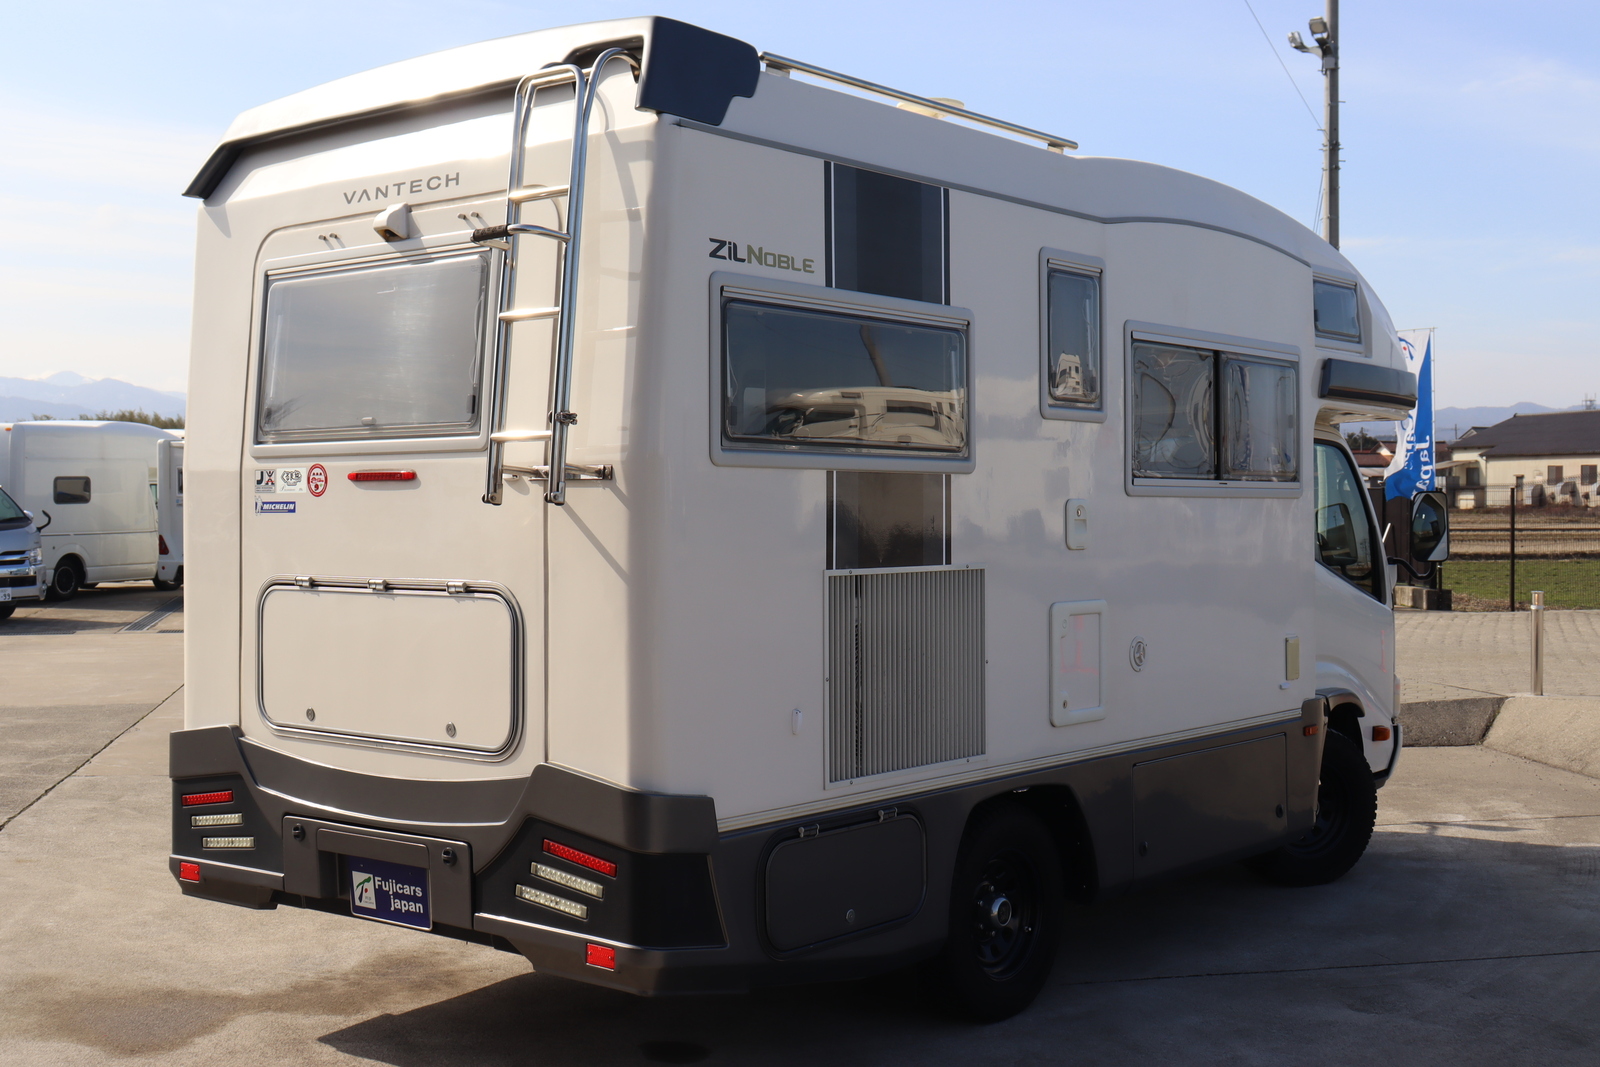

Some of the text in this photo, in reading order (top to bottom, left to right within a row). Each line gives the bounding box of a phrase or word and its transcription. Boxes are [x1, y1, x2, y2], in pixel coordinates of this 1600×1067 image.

[343, 172, 460, 205] VANTECH
[374, 876, 423, 897] Fujicars
[390, 895, 424, 914] japan
